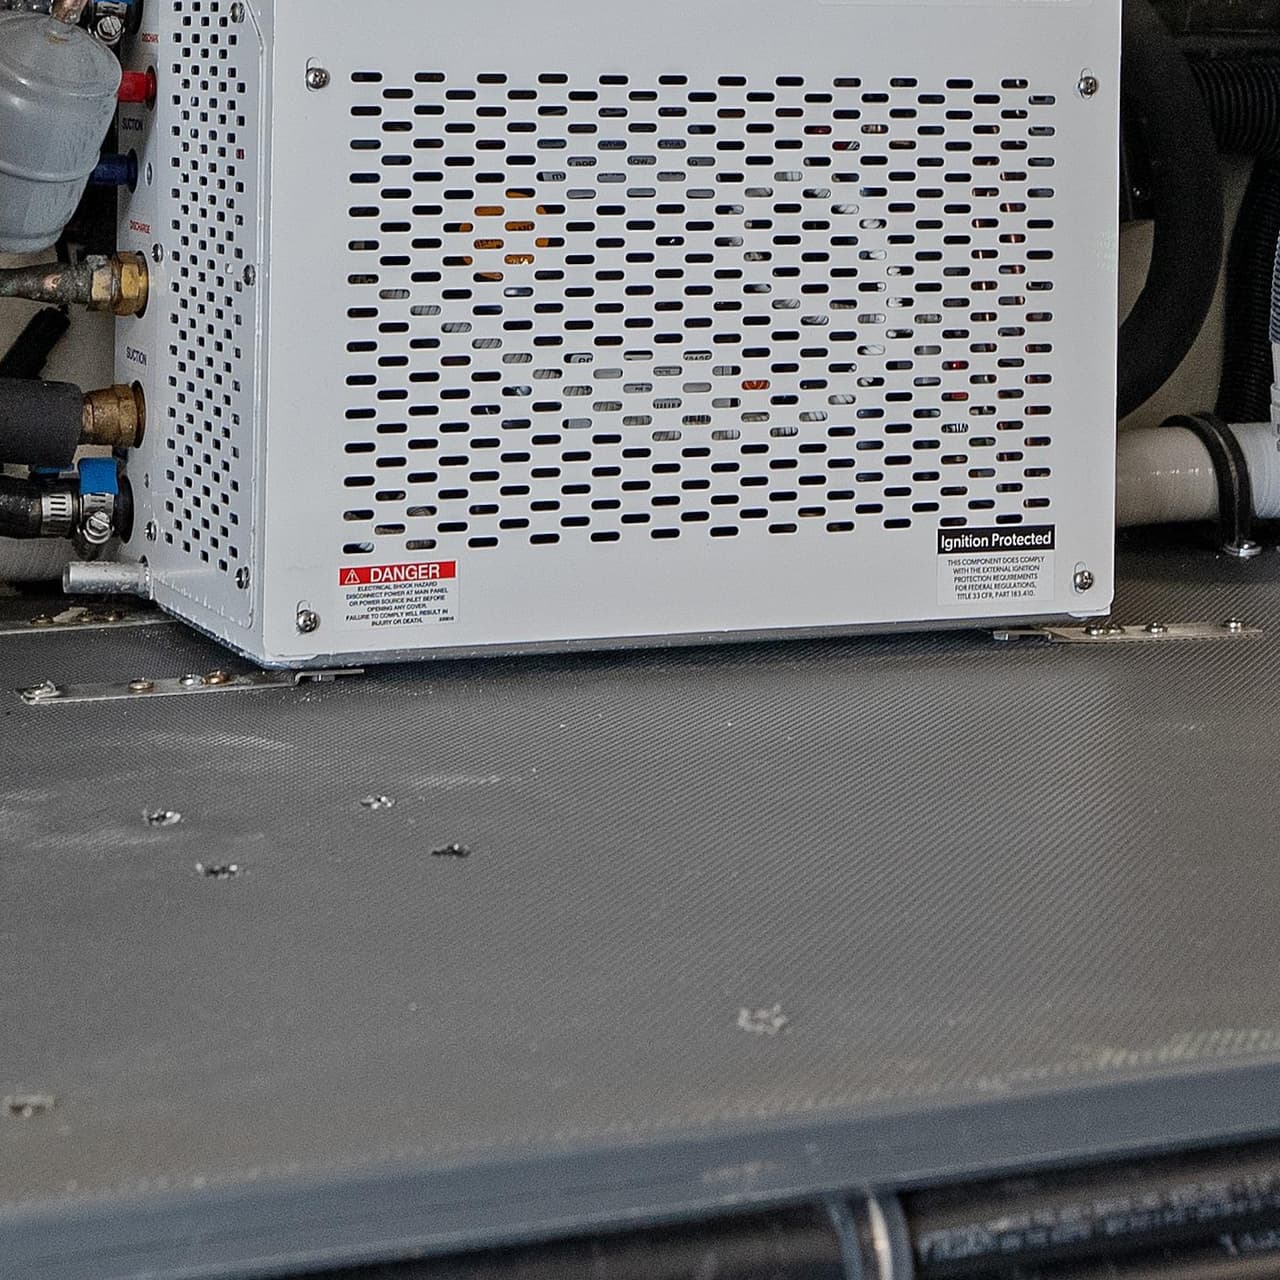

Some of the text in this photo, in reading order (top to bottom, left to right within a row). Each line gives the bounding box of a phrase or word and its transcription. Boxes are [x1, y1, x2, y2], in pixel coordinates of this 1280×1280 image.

[941, 531, 1052, 551] Ignition Protected
[962, 558, 1002, 566] COMPONENT
[1020, 556, 1045, 564] COMPLY
[370, 564, 440, 583] DANGER
[982, 566, 1011, 574] EXTERNAL
[954, 573, 1038, 583] PROTECTION REQUIREMENTS
[357, 584, 392, 592] ELECTRICAL
[955, 584, 967, 592] FOR
[968, 583, 993, 591] FEDERAL
[346, 592, 383, 600] DISCONNECT
[346, 613, 370, 621] FAILURE
